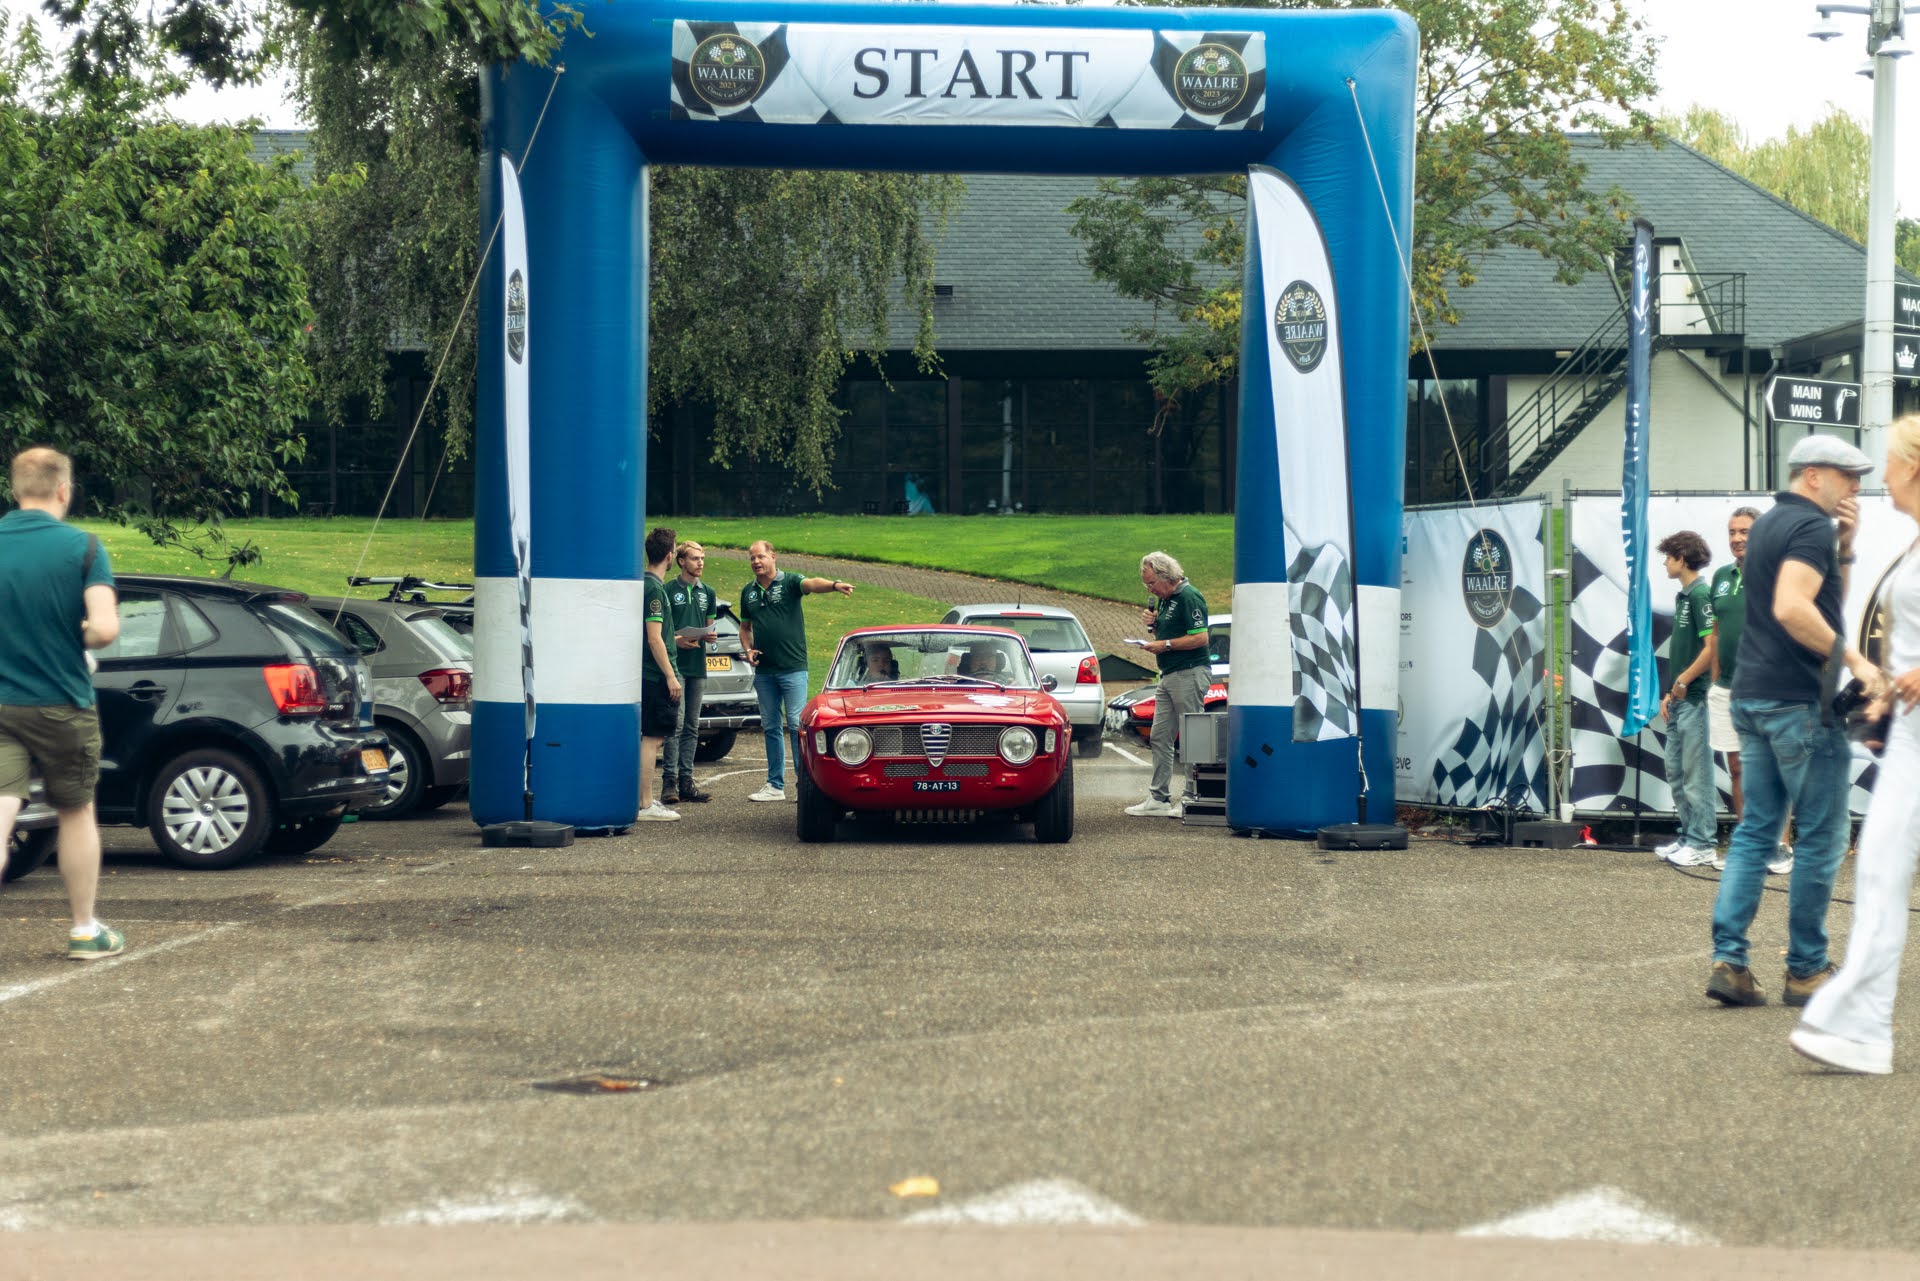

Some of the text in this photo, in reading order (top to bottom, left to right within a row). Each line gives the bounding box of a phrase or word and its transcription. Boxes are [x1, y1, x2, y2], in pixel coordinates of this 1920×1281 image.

[698, 67, 755, 80] WAALRE
[853, 47, 1090, 100] START
[719, 81, 737, 89] 2023
[1182, 76, 1238, 88] WAALRE
[707, 85, 723, 98] Classic
[1203, 90, 1221, 98] 2023
[1191, 94, 1207, 106] Classic
[1792, 385, 1822, 400] MAIN
[1790, 404, 1822, 419] WING
[1466, 575, 1507, 591] WAALRE
[1400, 613, 1412, 621] ORS
[707, 658, 729, 667] 90-KZ
[1203, 689, 1228, 698] SAN
[917, 782, 957, 790] 78-AT-13
